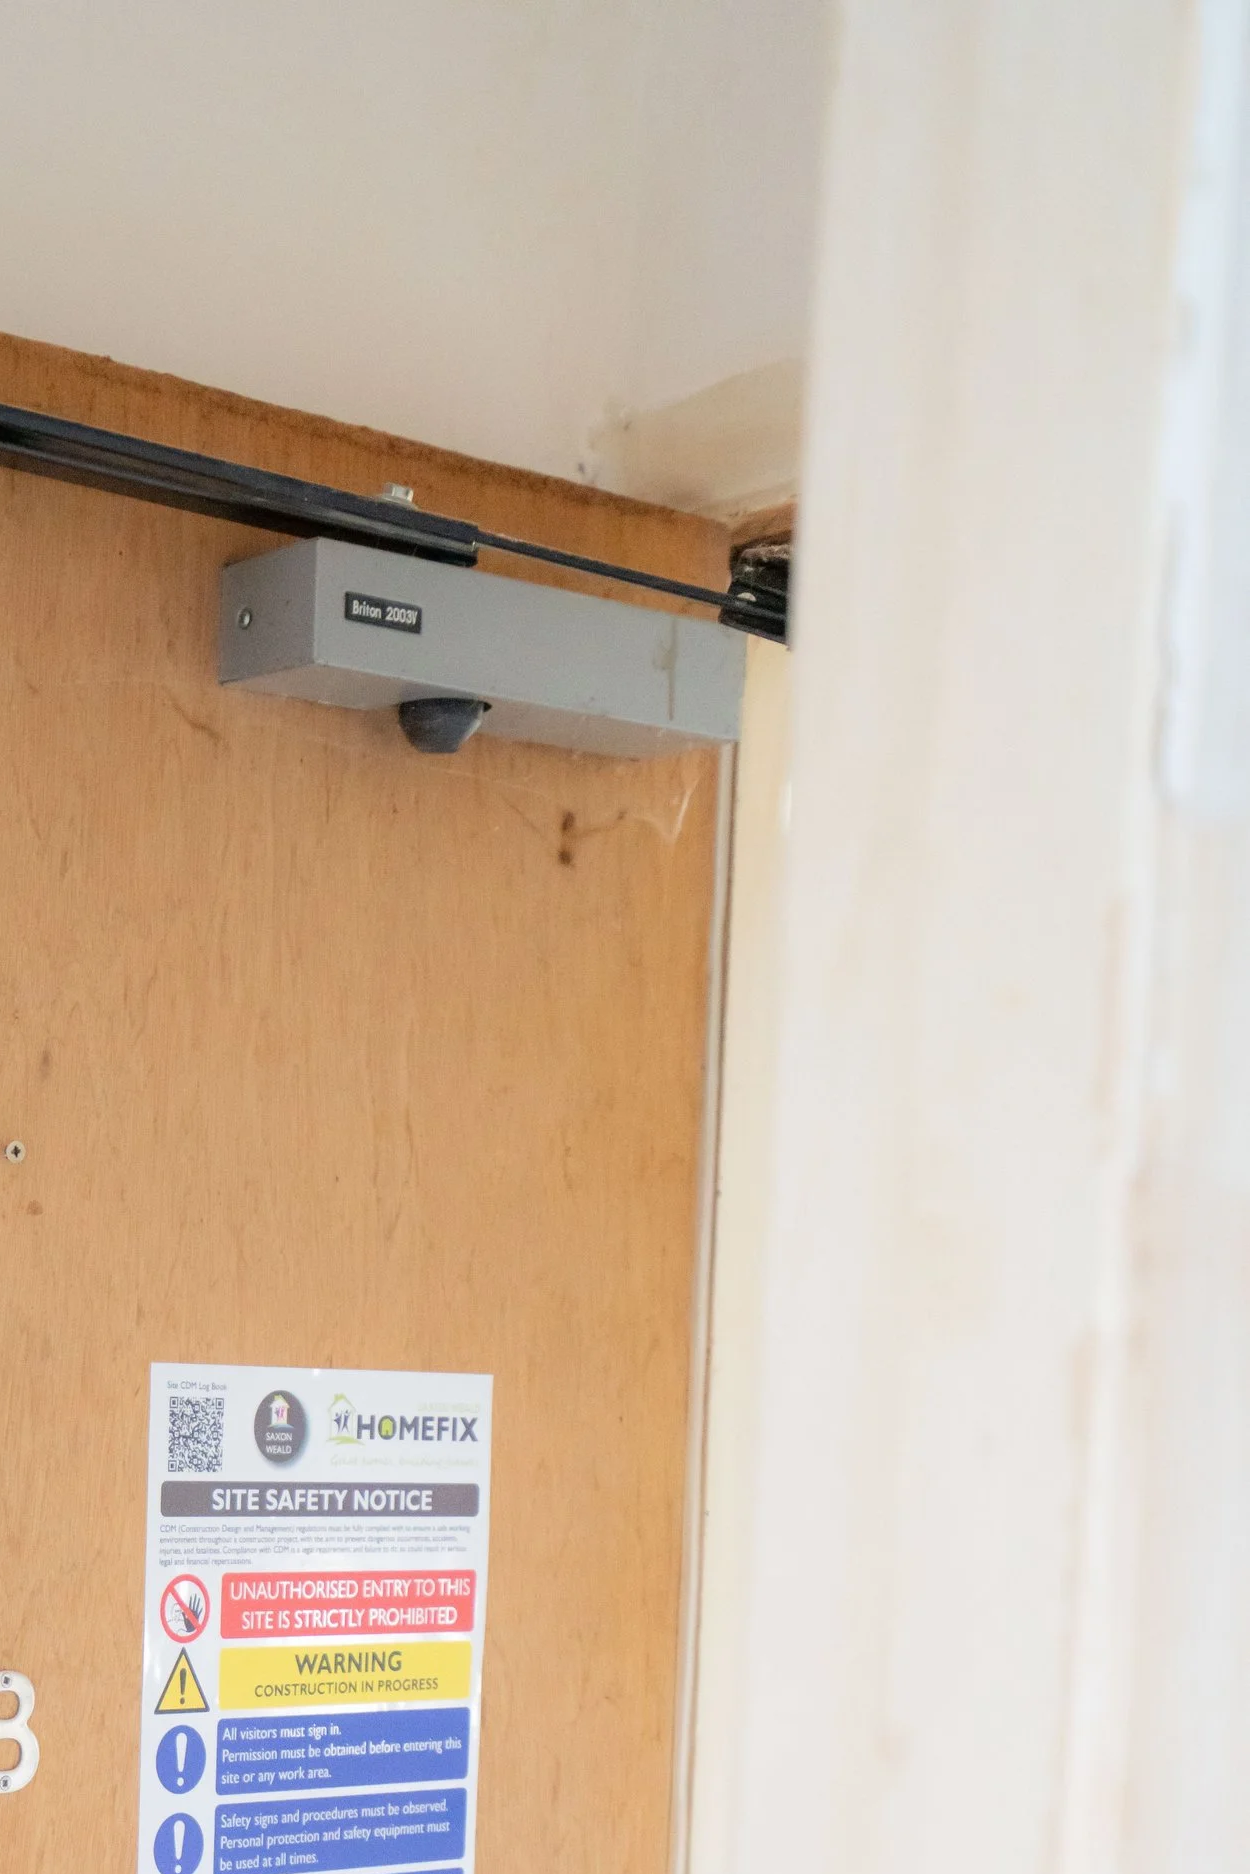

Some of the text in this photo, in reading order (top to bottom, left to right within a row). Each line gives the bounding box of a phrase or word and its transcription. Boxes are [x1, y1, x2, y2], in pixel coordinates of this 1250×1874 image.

[352, 600, 417, 624] Briton 2003V
[199, 1382, 209, 1391] Log
[265, 1433, 292, 1441] SAXON
[357, 1415, 478, 1442] HOMEFIX
[212, 1489, 433, 1511] SITE SAFETY NOTICE
[231, 1578, 470, 1600] UNAUTHORISED ENTRY TO THIS
[242, 1607, 458, 1629] SITE IS STRICTLY PROHIBITED
[295, 1651, 402, 1675] WARNING
[254, 1678, 438, 1697] CONSTRUCTION IN PROGRESS
[222, 1723, 342, 1740] All visitors must sign in.
[222, 1736, 462, 1763] Permission must be obtained before entering this
[222, 1766, 331, 1784] site or any work area.
[221, 1799, 448, 1830] Safety signs and procedures must be observed.
[220, 1822, 450, 1849] Personal protection and safety equipment must
[220, 1852, 318, 1871] be used at all times.
